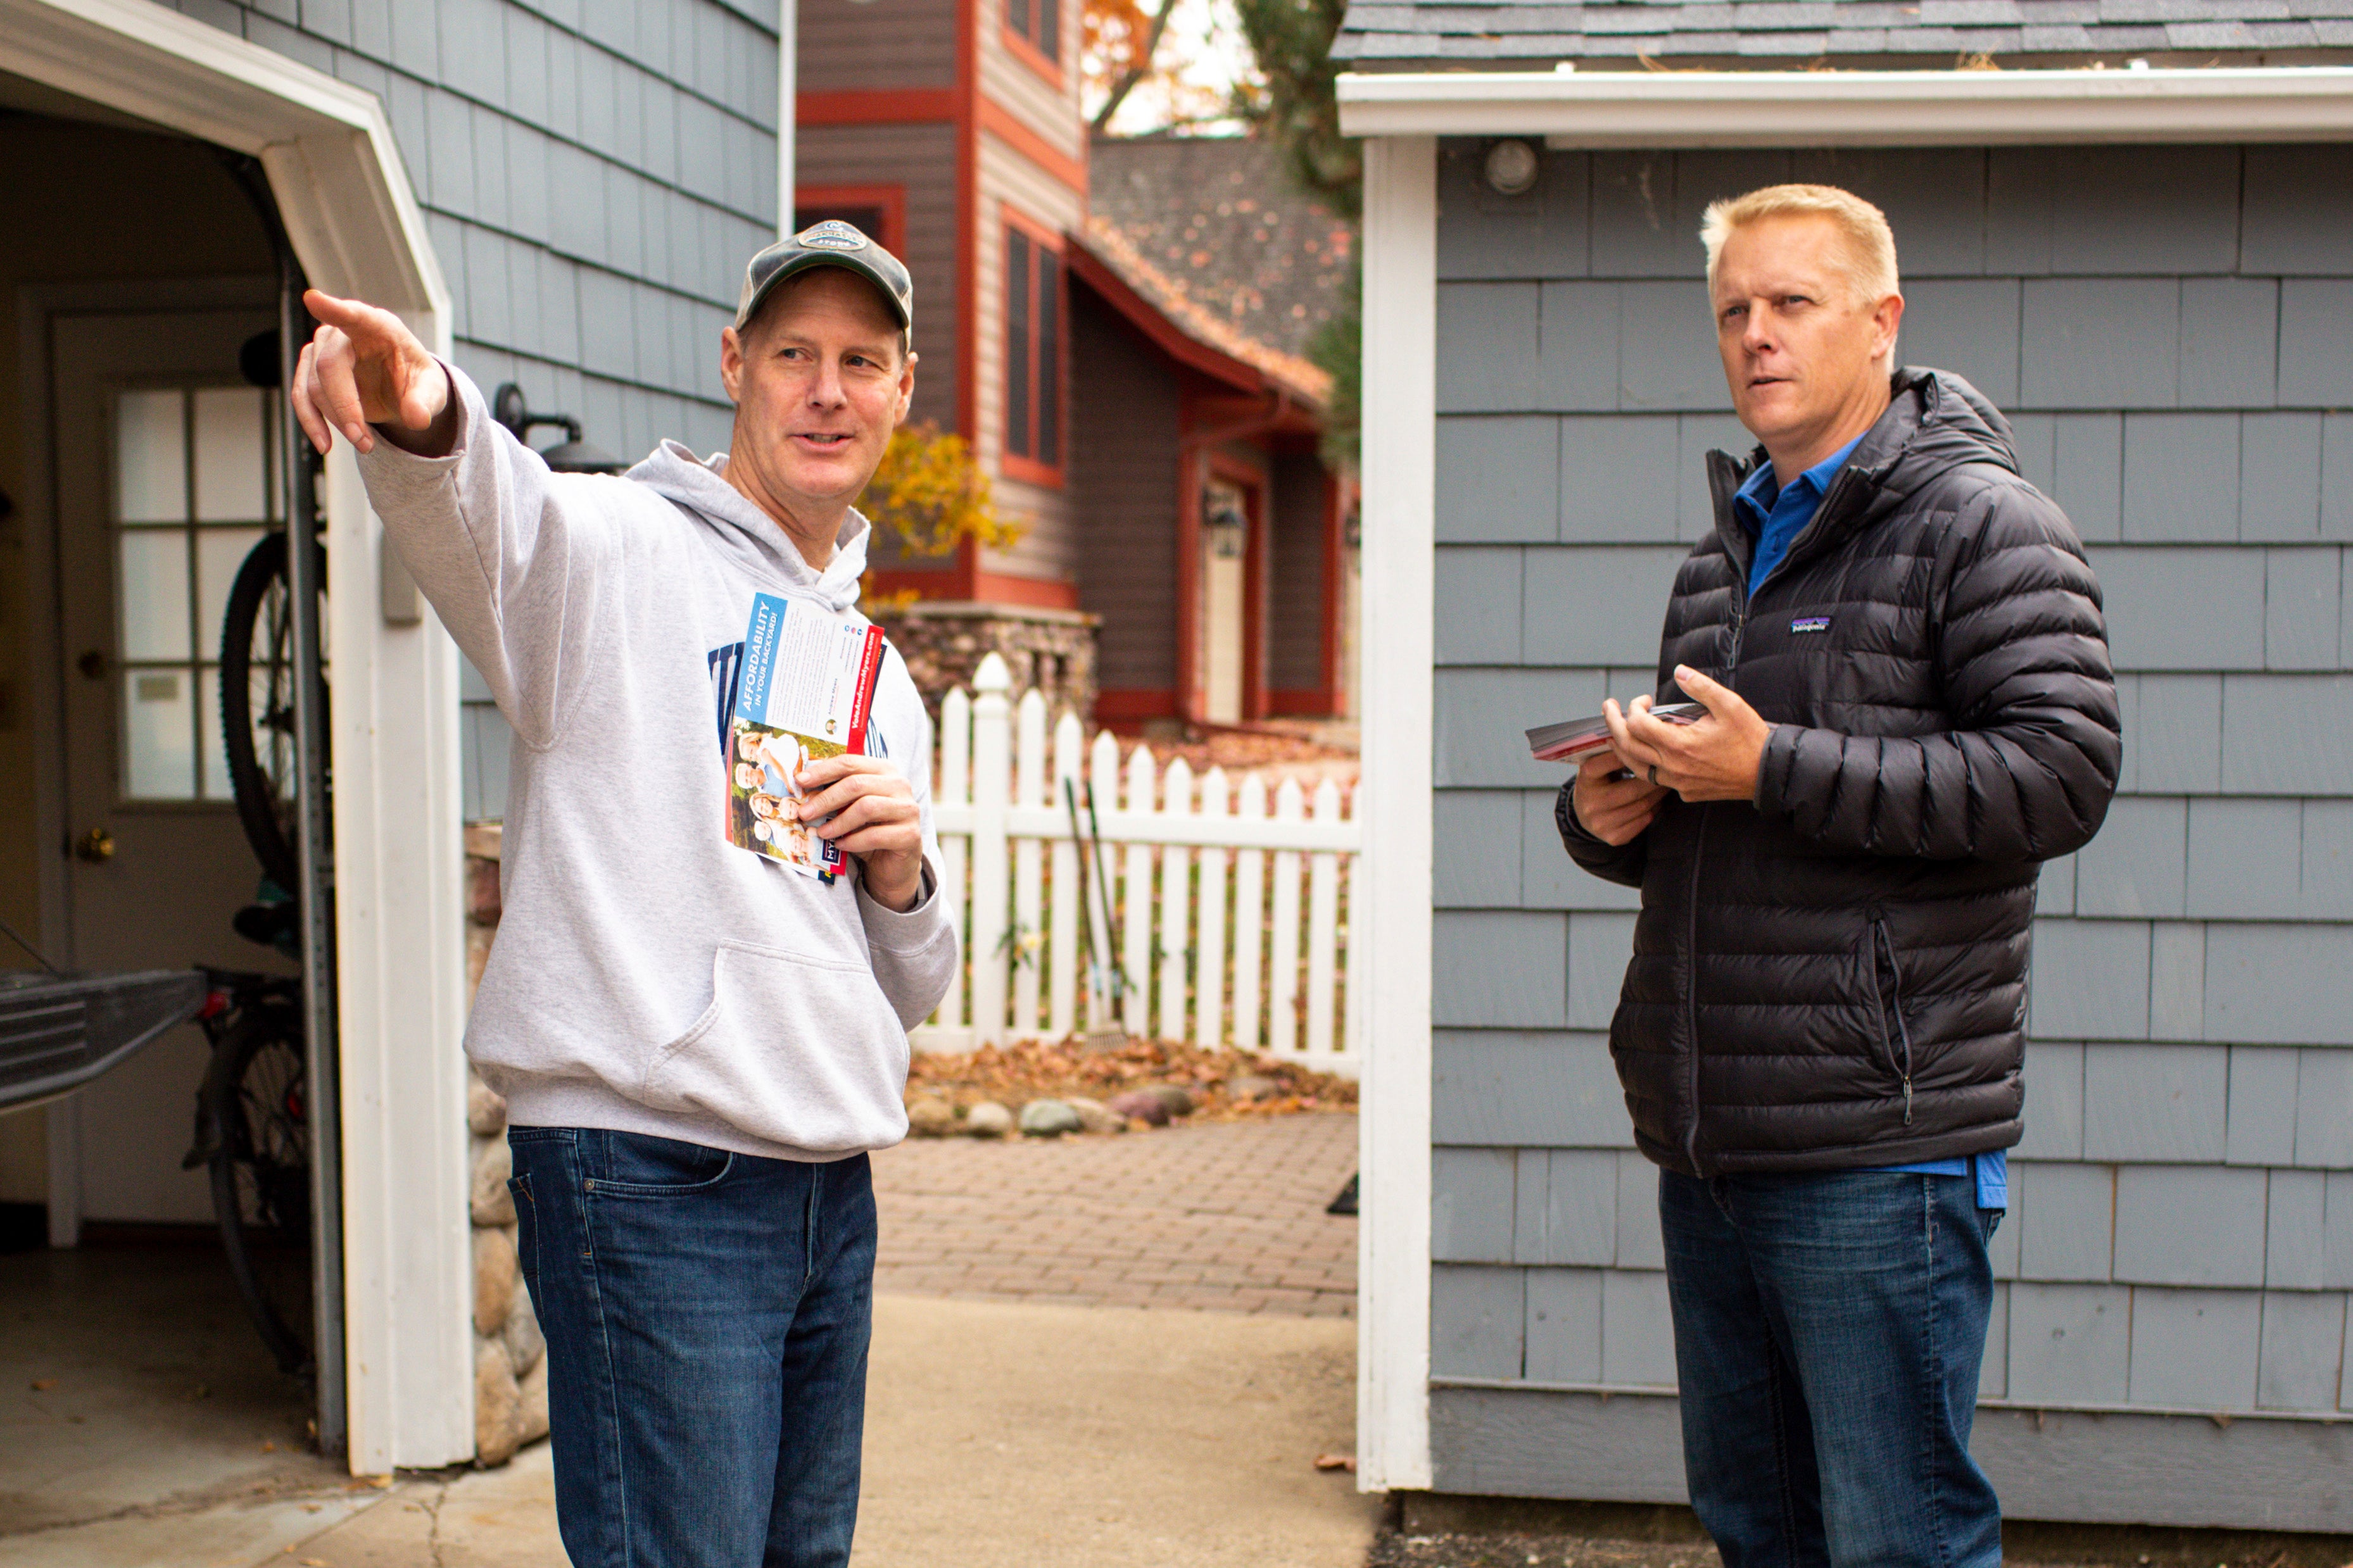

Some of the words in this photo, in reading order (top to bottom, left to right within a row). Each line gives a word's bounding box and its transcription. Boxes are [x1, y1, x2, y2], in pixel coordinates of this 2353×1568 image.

[743, 600, 770, 712] AFFORDABILITY
[762, 612, 778, 665] BACKYARD!
[754, 694, 762, 706] IN
[756, 665, 767, 692] YOUR
[851, 632, 875, 729] VoteAndrewMyers.com
